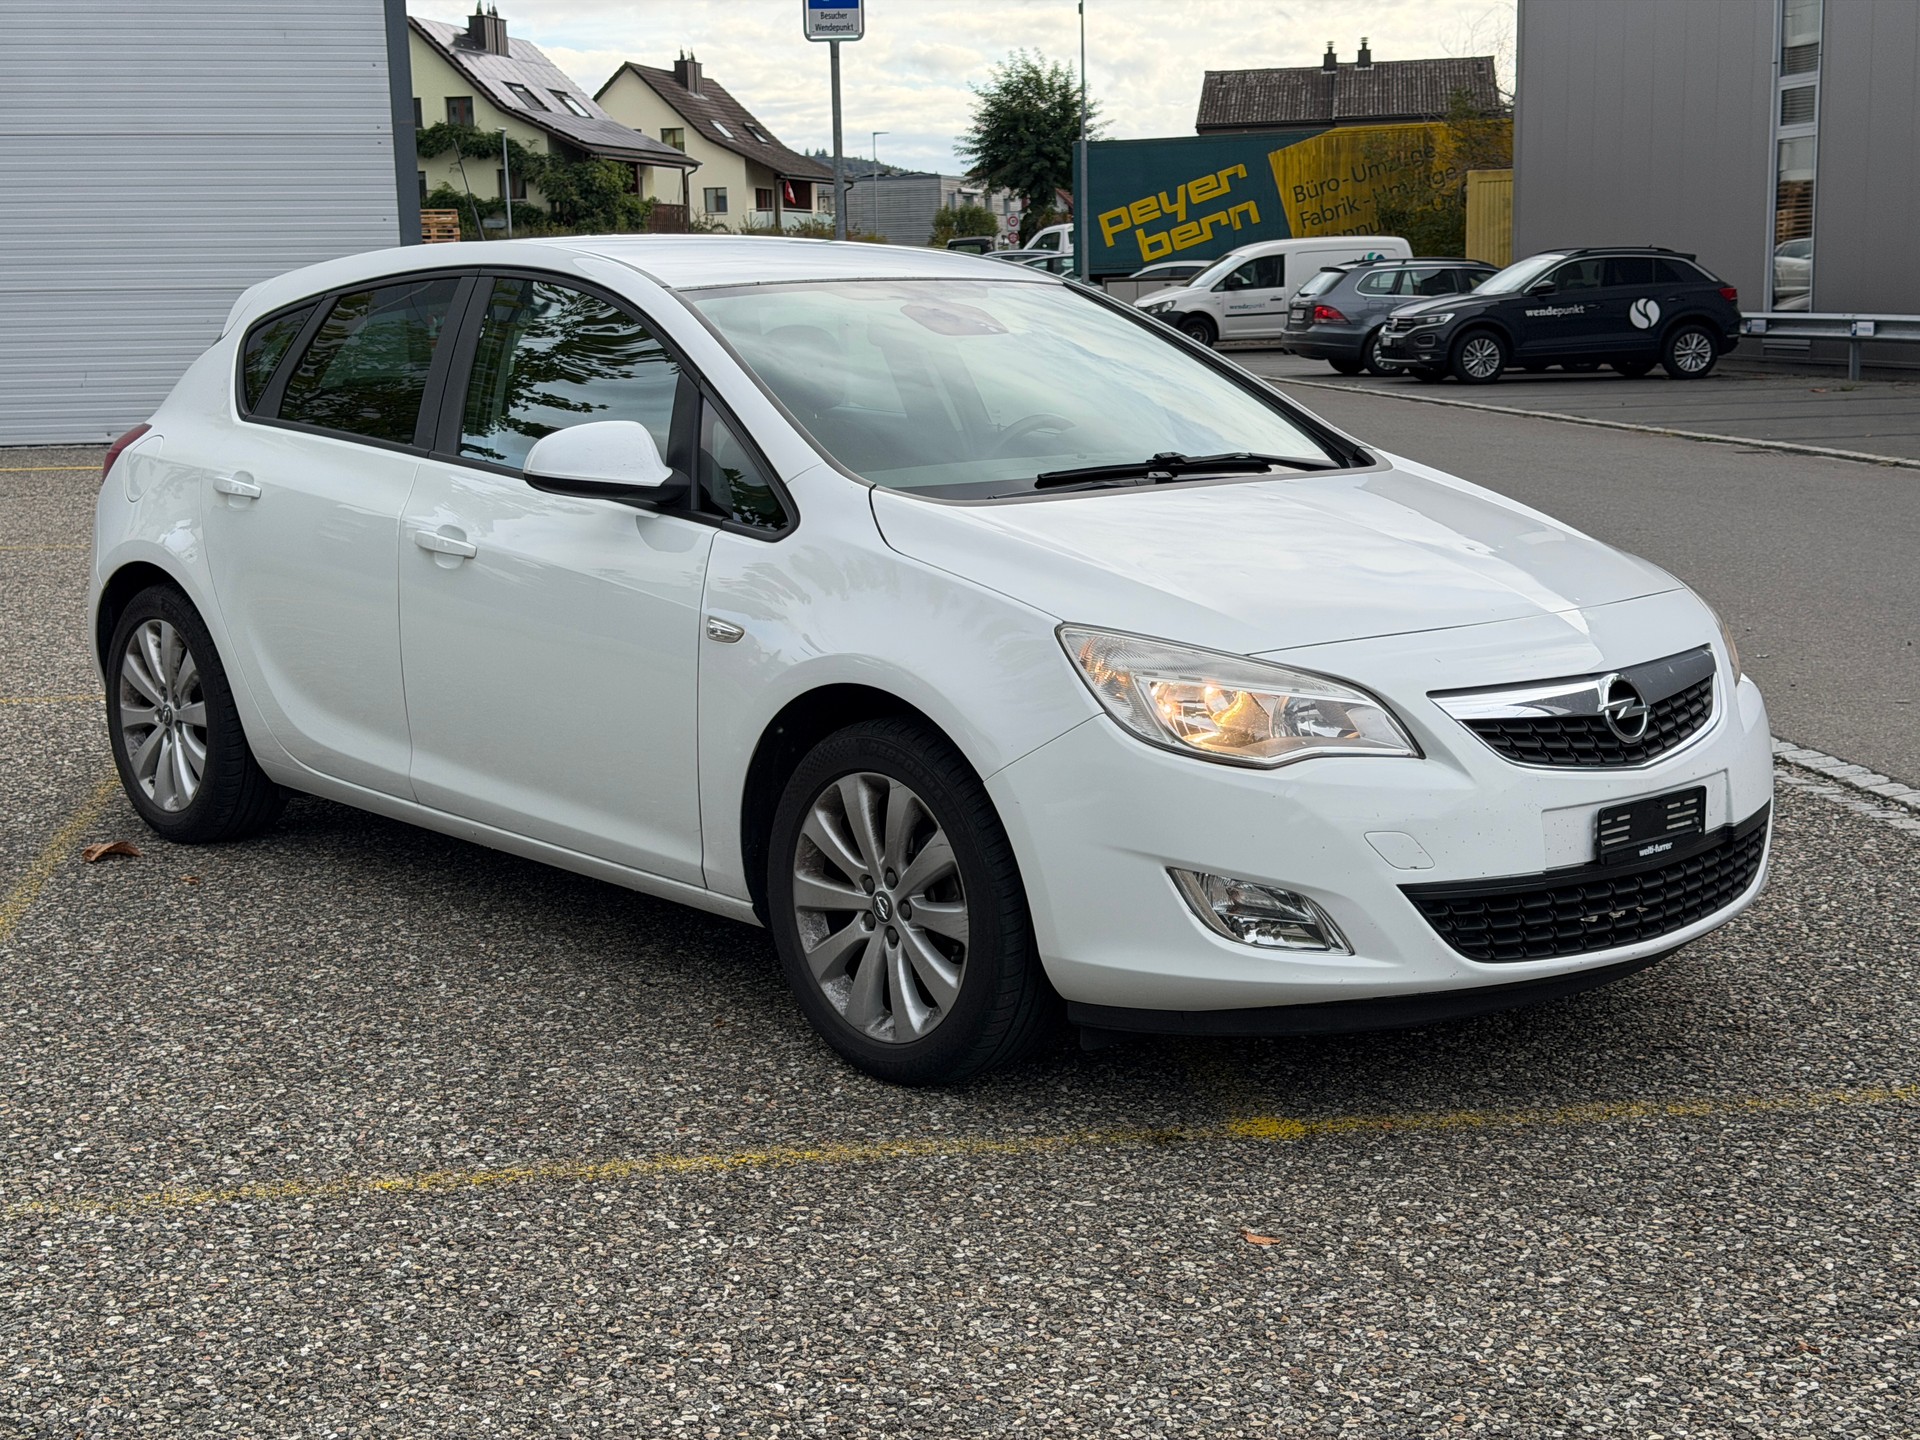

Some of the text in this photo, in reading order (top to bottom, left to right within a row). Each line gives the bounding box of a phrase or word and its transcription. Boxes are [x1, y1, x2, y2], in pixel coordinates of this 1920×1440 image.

[820, 11, 848, 20] Besucher
[815, 22, 854, 33] Wendepunkt
[1098, 163, 1248, 248] peyer
[1135, 199, 1261, 263] bern
[1525, 304, 1585, 317] wendepunkt
[1639, 841, 1673, 857] welti-furrer
